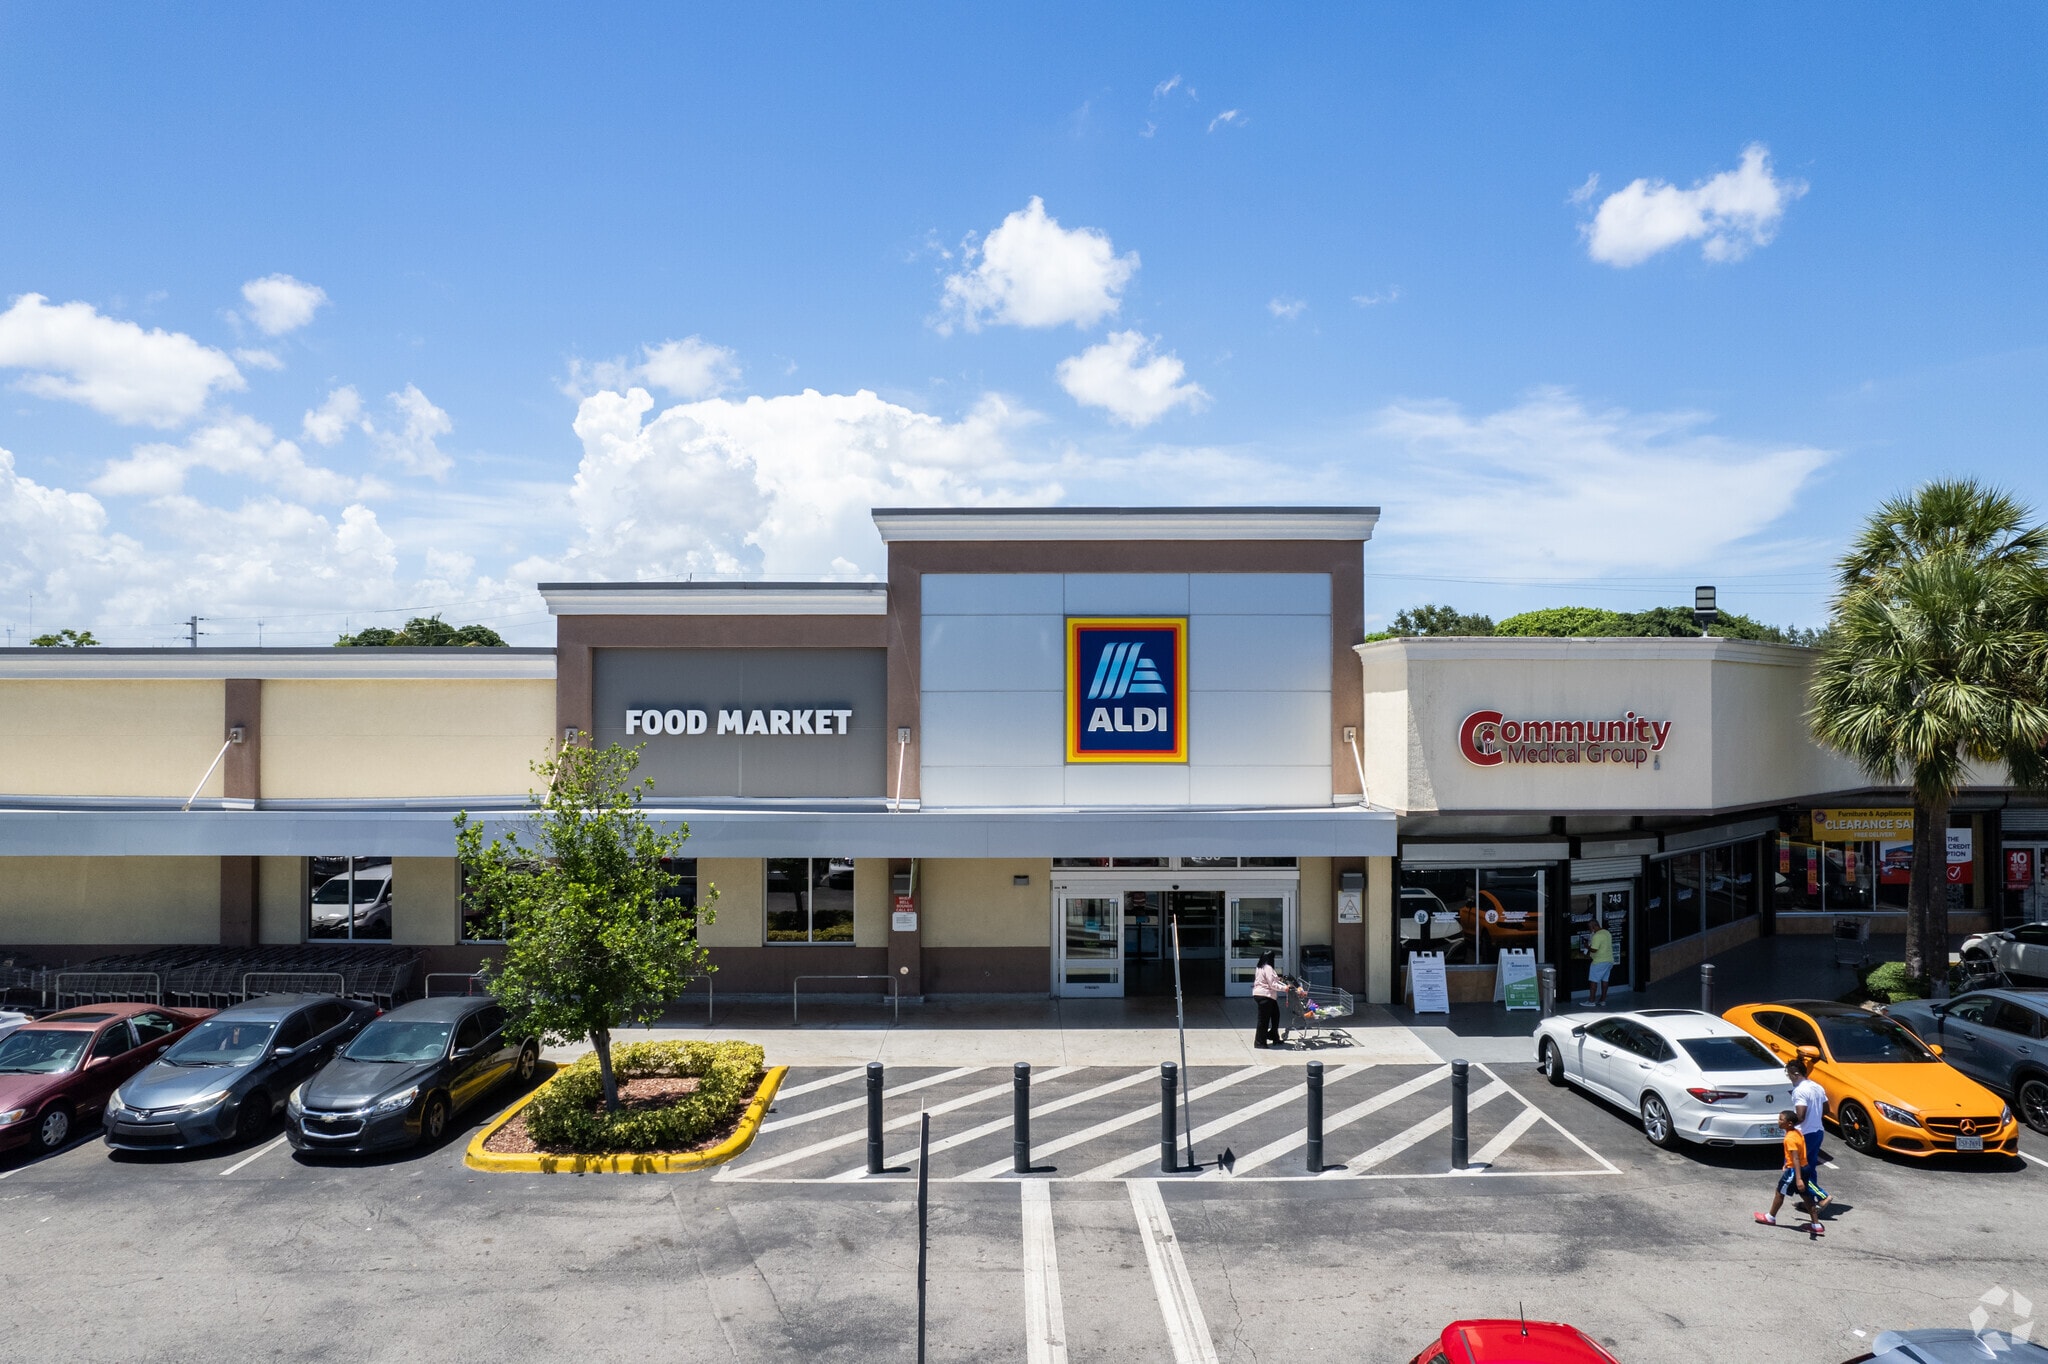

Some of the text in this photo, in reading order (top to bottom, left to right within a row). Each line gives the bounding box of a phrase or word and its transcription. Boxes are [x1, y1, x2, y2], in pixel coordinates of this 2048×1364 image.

[625, 709, 852, 735] FOOD MARKET
[1087, 707, 1168, 732] ALDI
[1459, 709, 1672, 767] Community
[1507, 743, 1648, 769] Medical Group
[1825, 820, 1914, 830] CLEARANCE SA
[1608, 893, 1622, 904] 743
